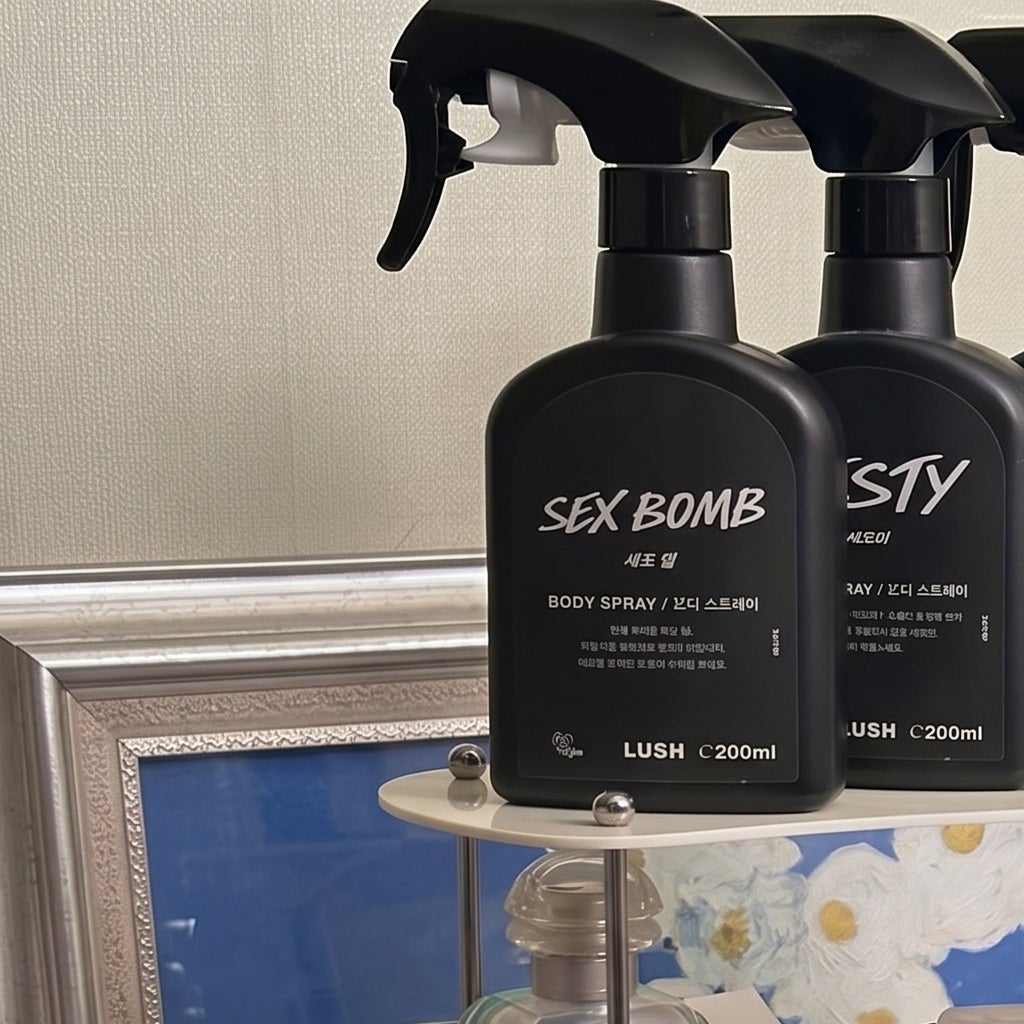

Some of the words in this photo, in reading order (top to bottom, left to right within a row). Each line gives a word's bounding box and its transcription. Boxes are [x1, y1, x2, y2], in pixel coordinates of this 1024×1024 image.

[847, 454, 971, 515] STY
[538, 489, 629, 534] SEX
[631, 487, 766, 532] BOMB
[548, 596, 595, 610] BODY
[600, 596, 656, 611] SPRAY
[847, 722, 896, 739] USH
[624, 742, 684, 760] LUSH
